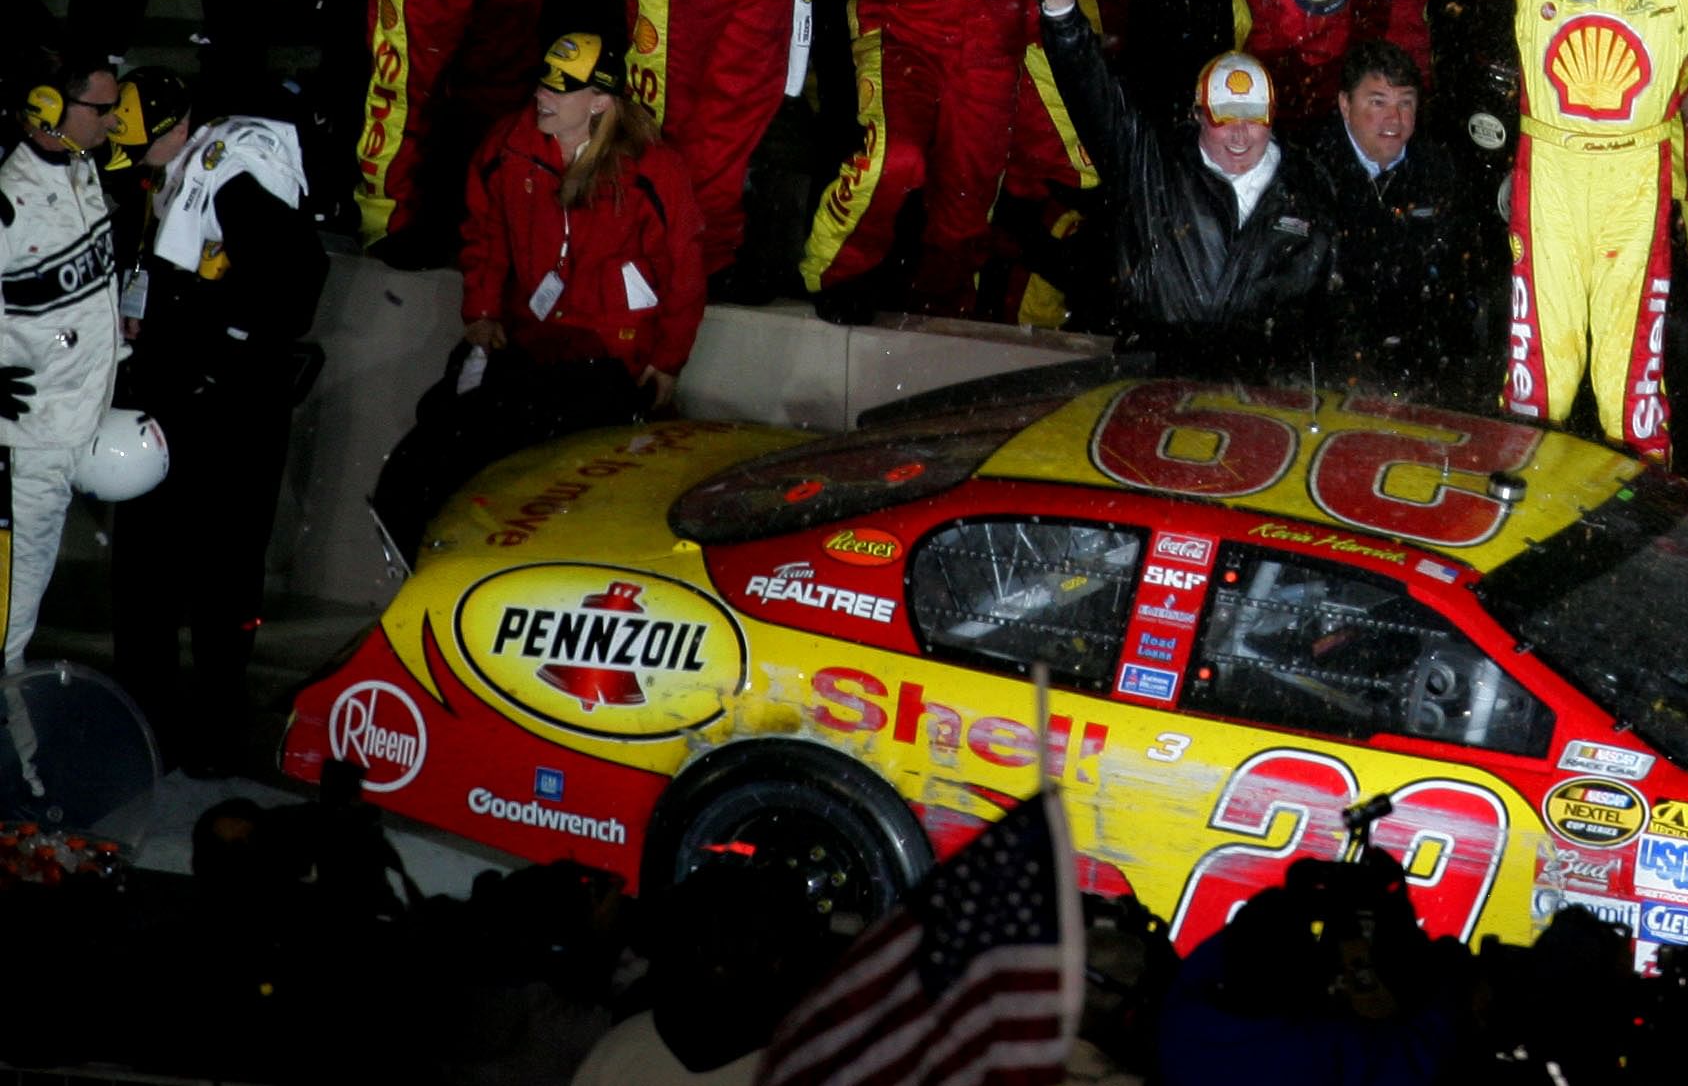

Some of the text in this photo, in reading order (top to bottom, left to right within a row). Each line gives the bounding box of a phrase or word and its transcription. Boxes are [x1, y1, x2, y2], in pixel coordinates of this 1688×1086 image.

[1631, 278, 1671, 439] Shell
[826, 529, 895, 558] Reese's
[745, 574, 895, 623] REALTREE
[1143, 566, 1207, 591] SKF
[493, 609, 706, 671] PENNZOIL
[1140, 633, 1176, 648] Road
[341, 694, 418, 770] Rheem
[810, 666, 1109, 783] Shell
[1146, 732, 1192, 762] 3
[467, 786, 626, 845] Goodwrench
[1564, 804, 1623, 823] NEXTEL
